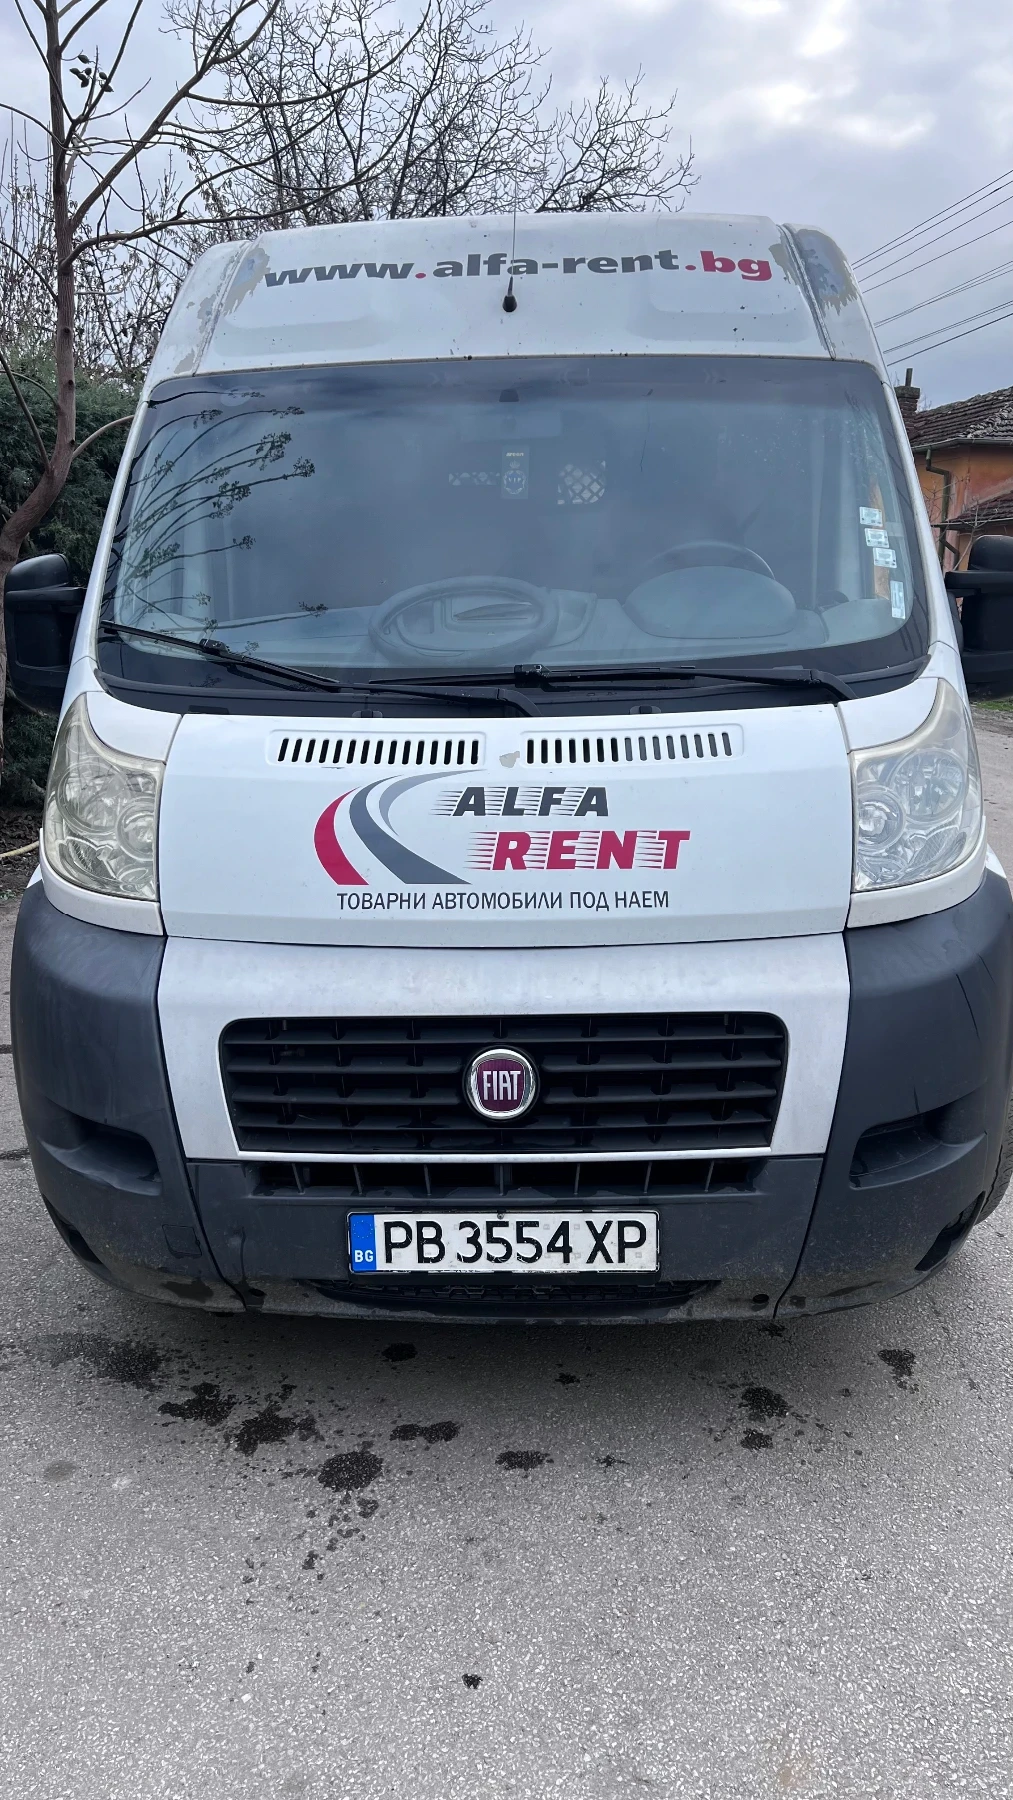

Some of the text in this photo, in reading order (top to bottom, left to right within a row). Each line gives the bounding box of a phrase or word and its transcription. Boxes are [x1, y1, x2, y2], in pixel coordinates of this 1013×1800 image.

[265, 249, 773, 287] www.alfa-rent.bg
[452, 786, 609, 817] ALFA
[491, 829, 691, 870] RENT
[337, 890, 670, 912] ТОВАРНИ АВТОМОБИЛИ ПОД НАЕМ
[482, 1070, 521, 1101] FIAT
[354, 1249, 375, 1263] BG
[383, 1220, 647, 1264] PB 3554 XP
